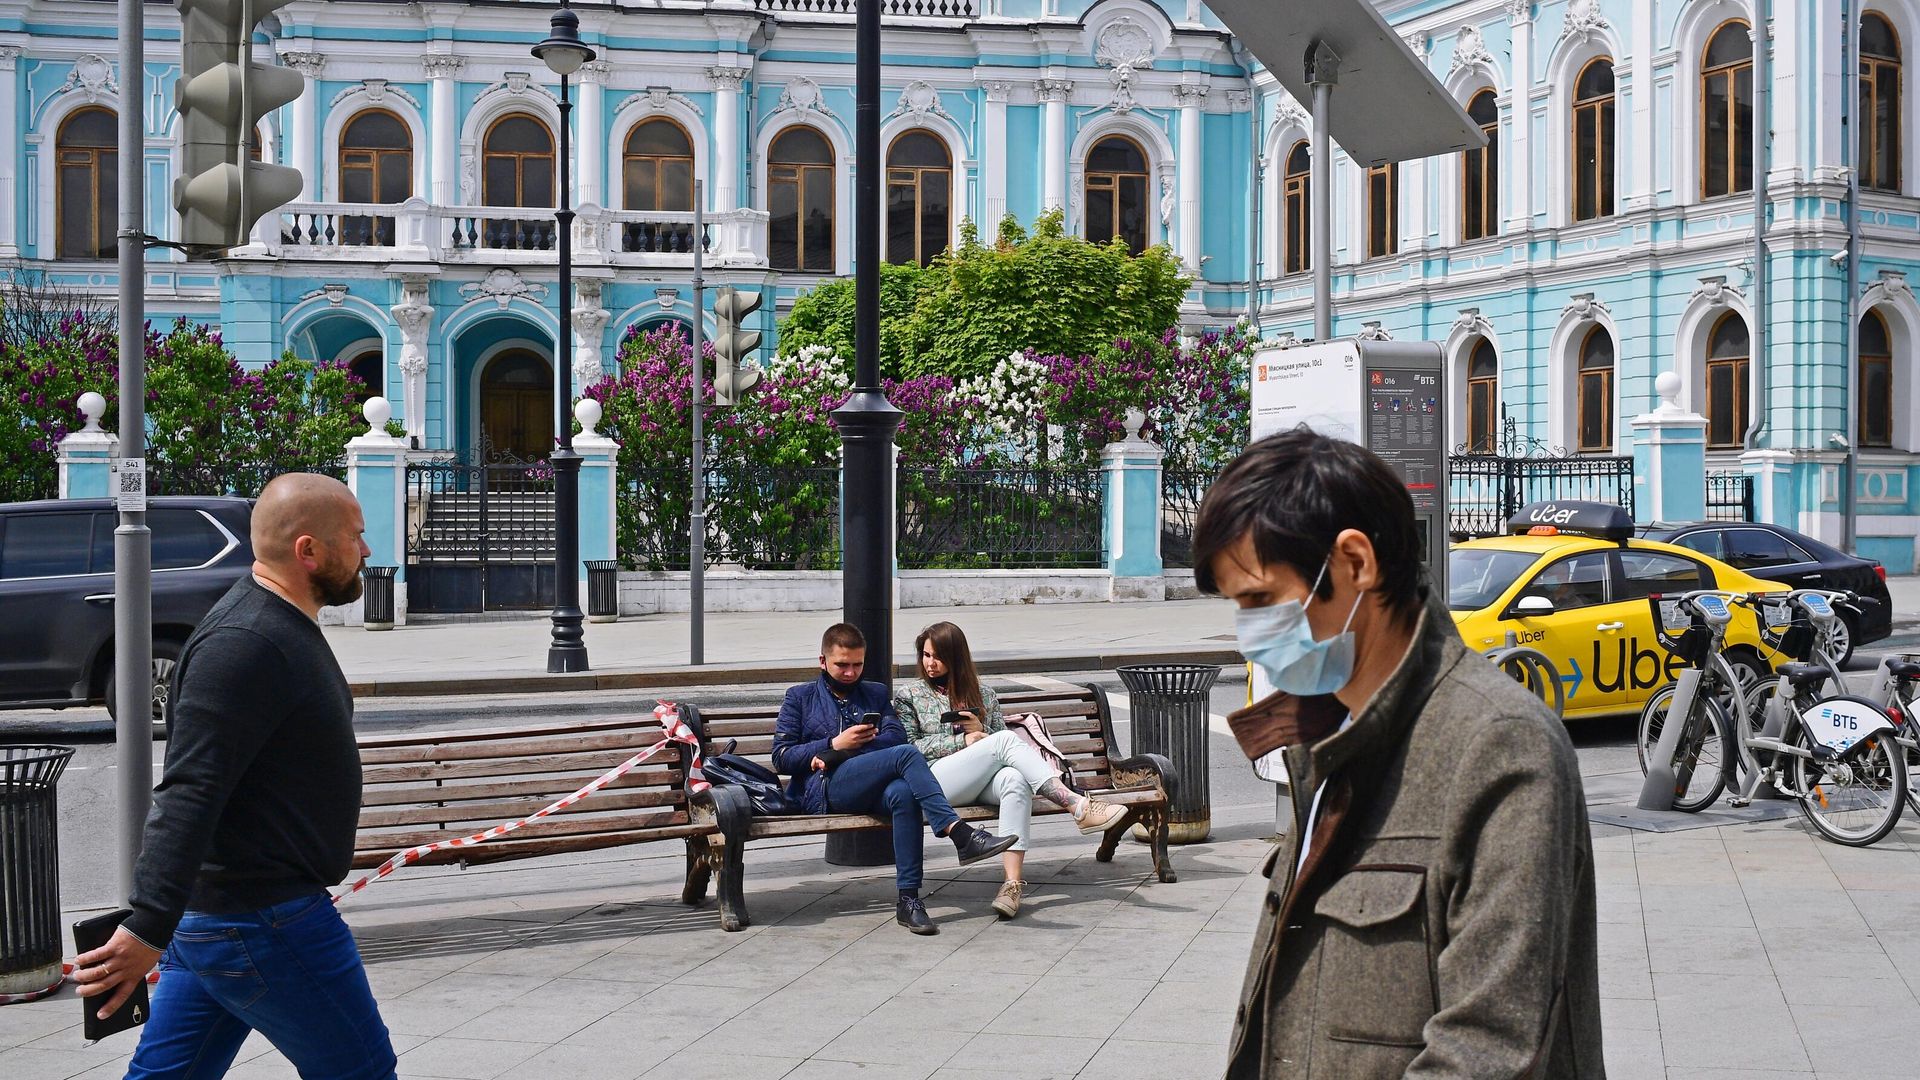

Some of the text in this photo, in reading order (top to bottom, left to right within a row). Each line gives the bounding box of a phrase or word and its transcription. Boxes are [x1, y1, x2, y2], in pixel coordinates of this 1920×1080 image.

[1384, 377, 1396, 385] 016
[1420, 376, 1435, 385] ВТБ
[1592, 637, 1693, 693] Ube
[1832, 713, 1858, 731] ВТБ
